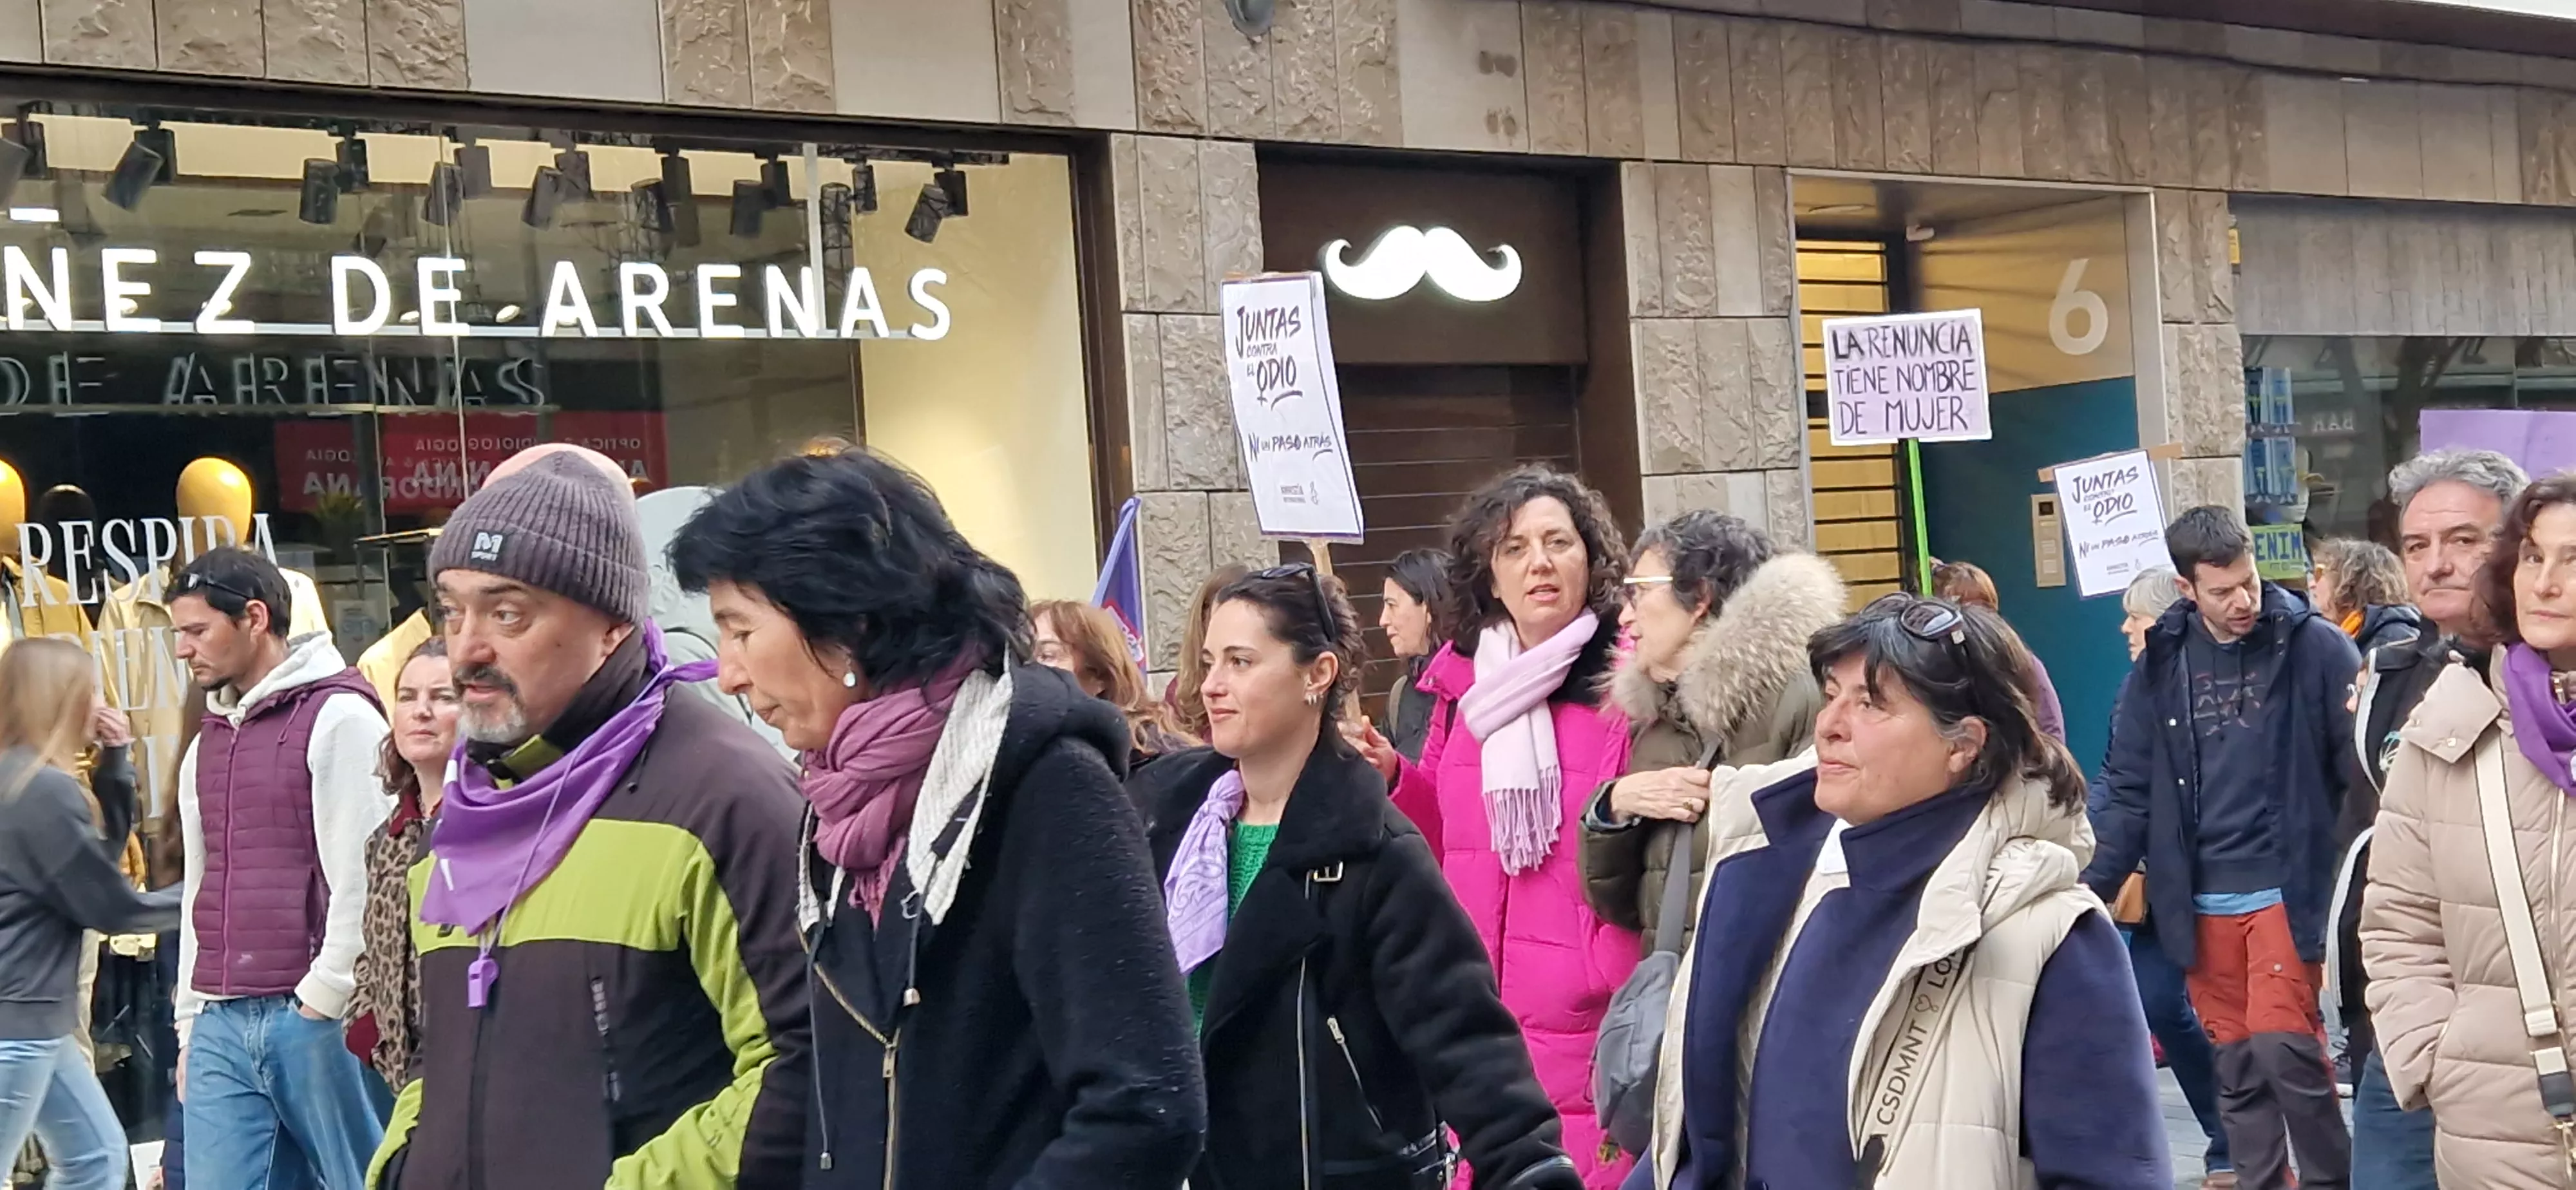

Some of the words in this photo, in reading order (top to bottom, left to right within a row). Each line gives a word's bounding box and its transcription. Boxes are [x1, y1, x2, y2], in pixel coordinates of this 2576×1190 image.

[3, 247, 255, 335] NEZ
[330, 255, 470, 337] DE
[542, 260, 951, 341] ARENAS
[2049, 258, 2108, 355] 6
[1235, 305, 1302, 359] JUNTAS
[1832, 328, 1864, 359] LA
[1256, 355, 1297, 406] ODIO
[1834, 365, 1889, 395] TIENE
[1896, 359, 1976, 393] NOMBRE
[1837, 401, 1868, 435] DE
[1885, 396, 1968, 432] MUJER
[1248, 432, 1259, 462] NI
[1272, 434, 1302, 451] PASO
[2071, 466, 2139, 504] JUNTAS
[2092, 493, 2134, 525] ODIO
[1877, 1020, 1928, 1126] CSDMNT
[1927, 951, 1956, 988] LO
